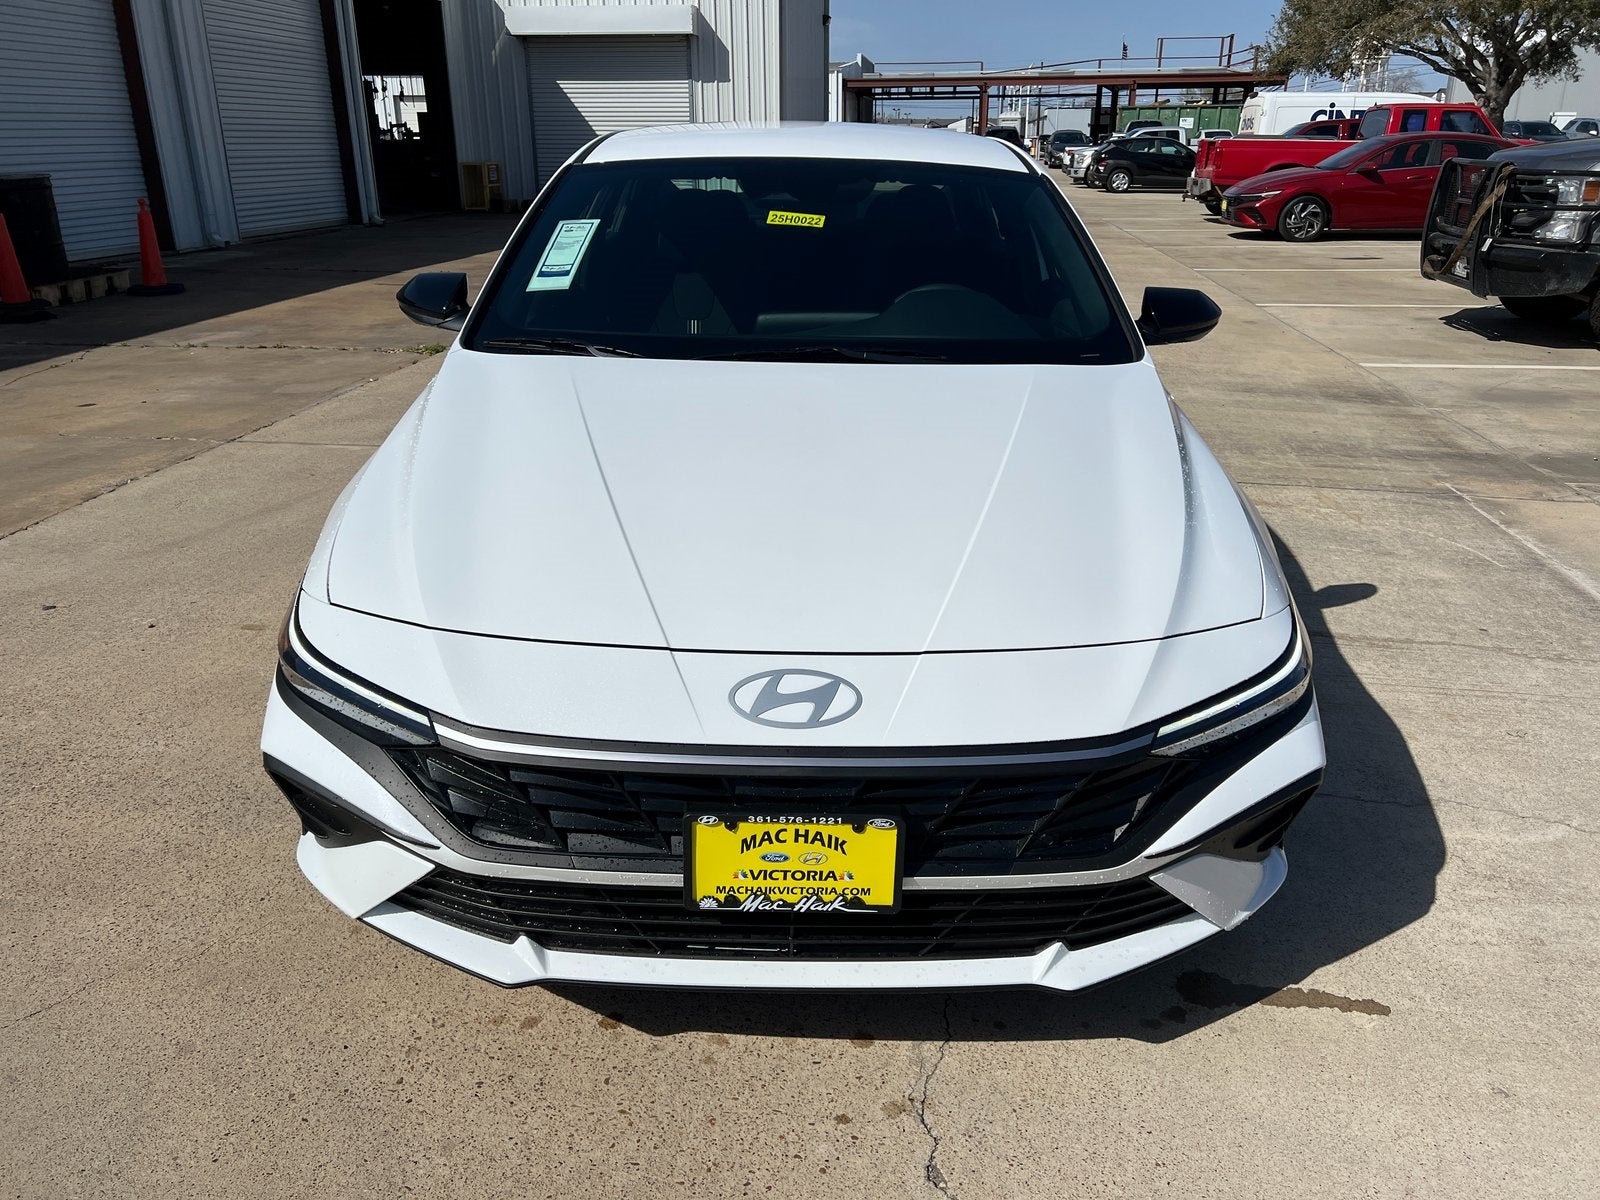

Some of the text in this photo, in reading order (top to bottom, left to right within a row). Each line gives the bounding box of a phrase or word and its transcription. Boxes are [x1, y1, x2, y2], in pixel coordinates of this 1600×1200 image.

[770, 213, 822, 225] 25H0022
[747, 815, 843, 824] 361-576-1221
[740, 828, 848, 856] MAC HAIK
[762, 853, 787, 862] Ford
[749, 869, 838, 881] VICTORIA
[715, 886, 871, 896] MACHAIKVICTORIA.COM
[739, 894, 858, 913] Mac Haik
